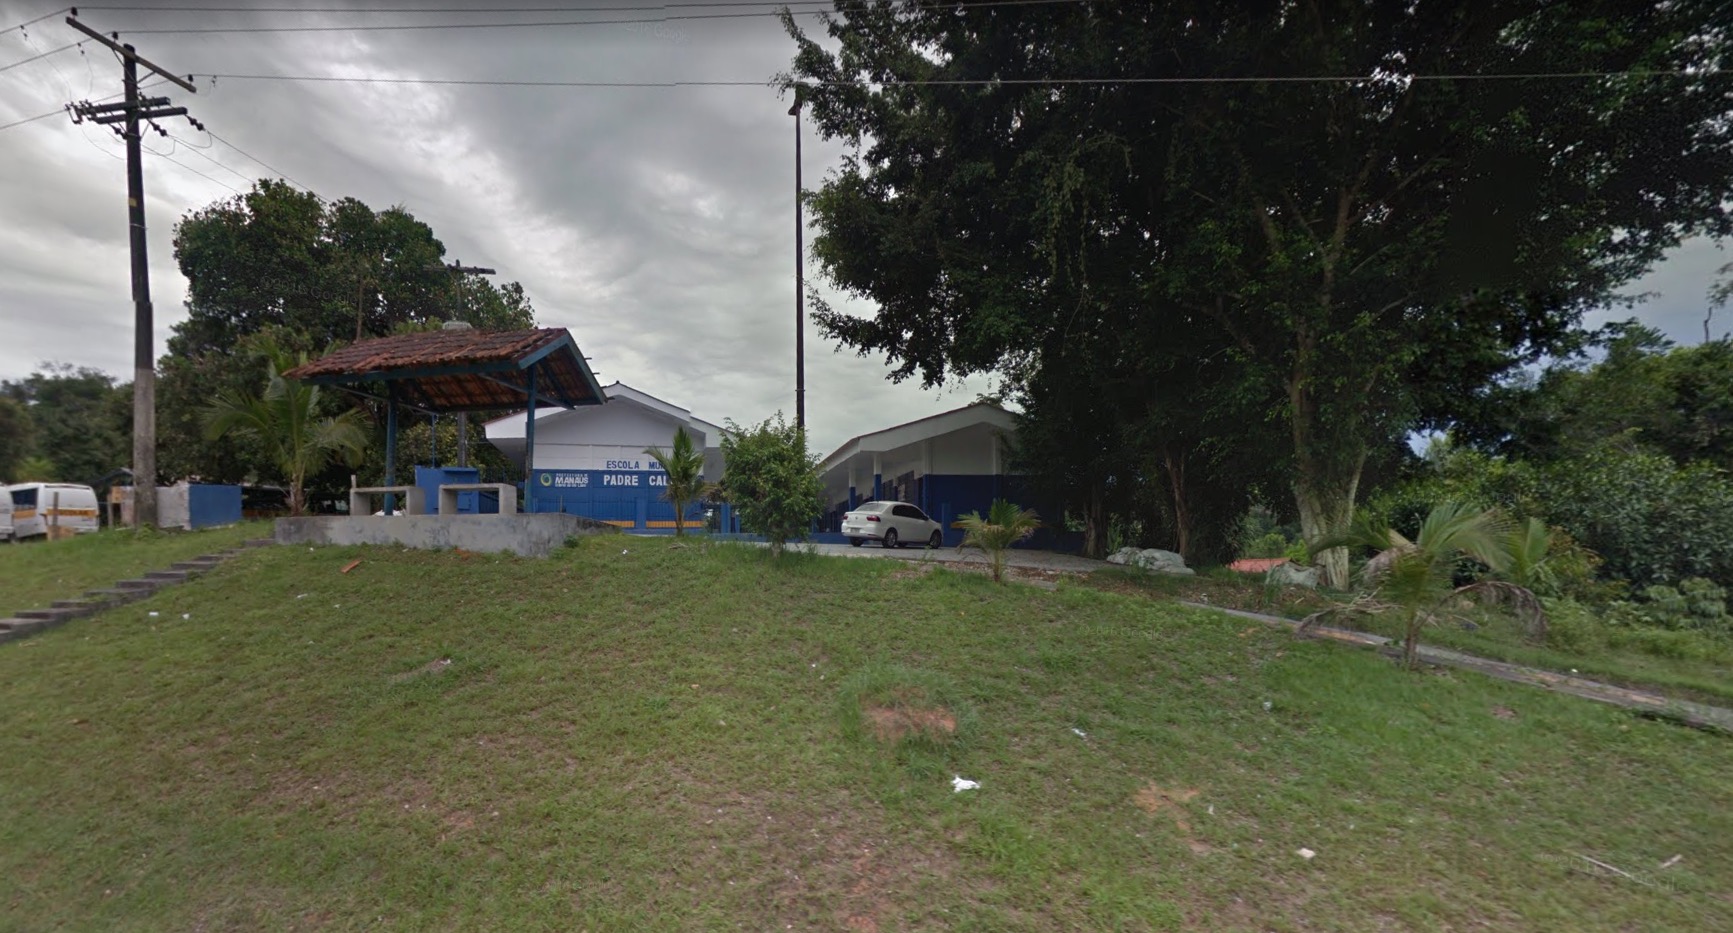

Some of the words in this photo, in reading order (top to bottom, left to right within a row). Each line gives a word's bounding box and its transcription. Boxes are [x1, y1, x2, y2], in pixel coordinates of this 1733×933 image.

[606, 460, 640, 469] ESCOLA
[555, 476, 589, 484] MANAUS
[603, 474, 639, 486] PADRE
[648, 475, 670, 486] CAL
